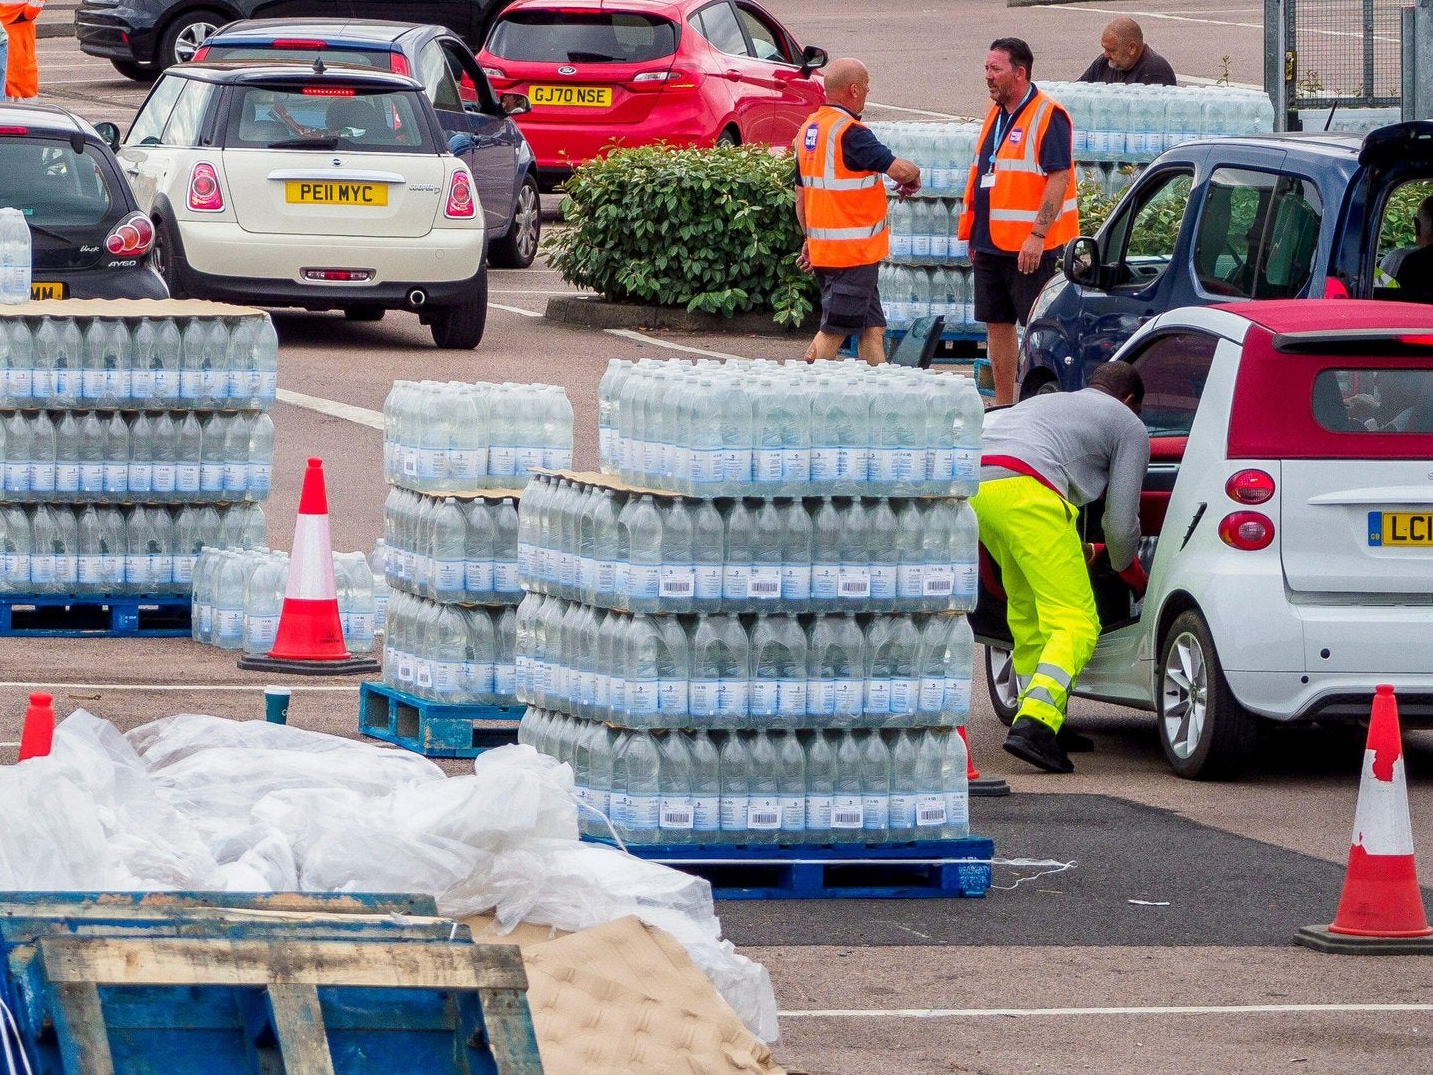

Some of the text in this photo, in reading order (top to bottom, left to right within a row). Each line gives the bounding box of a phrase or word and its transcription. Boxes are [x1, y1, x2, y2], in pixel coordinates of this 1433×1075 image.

[535, 87, 606, 103] GJ70 NSE
[300, 183, 373, 202] PE11 MYC
[108, 260, 137, 268] AYGO
